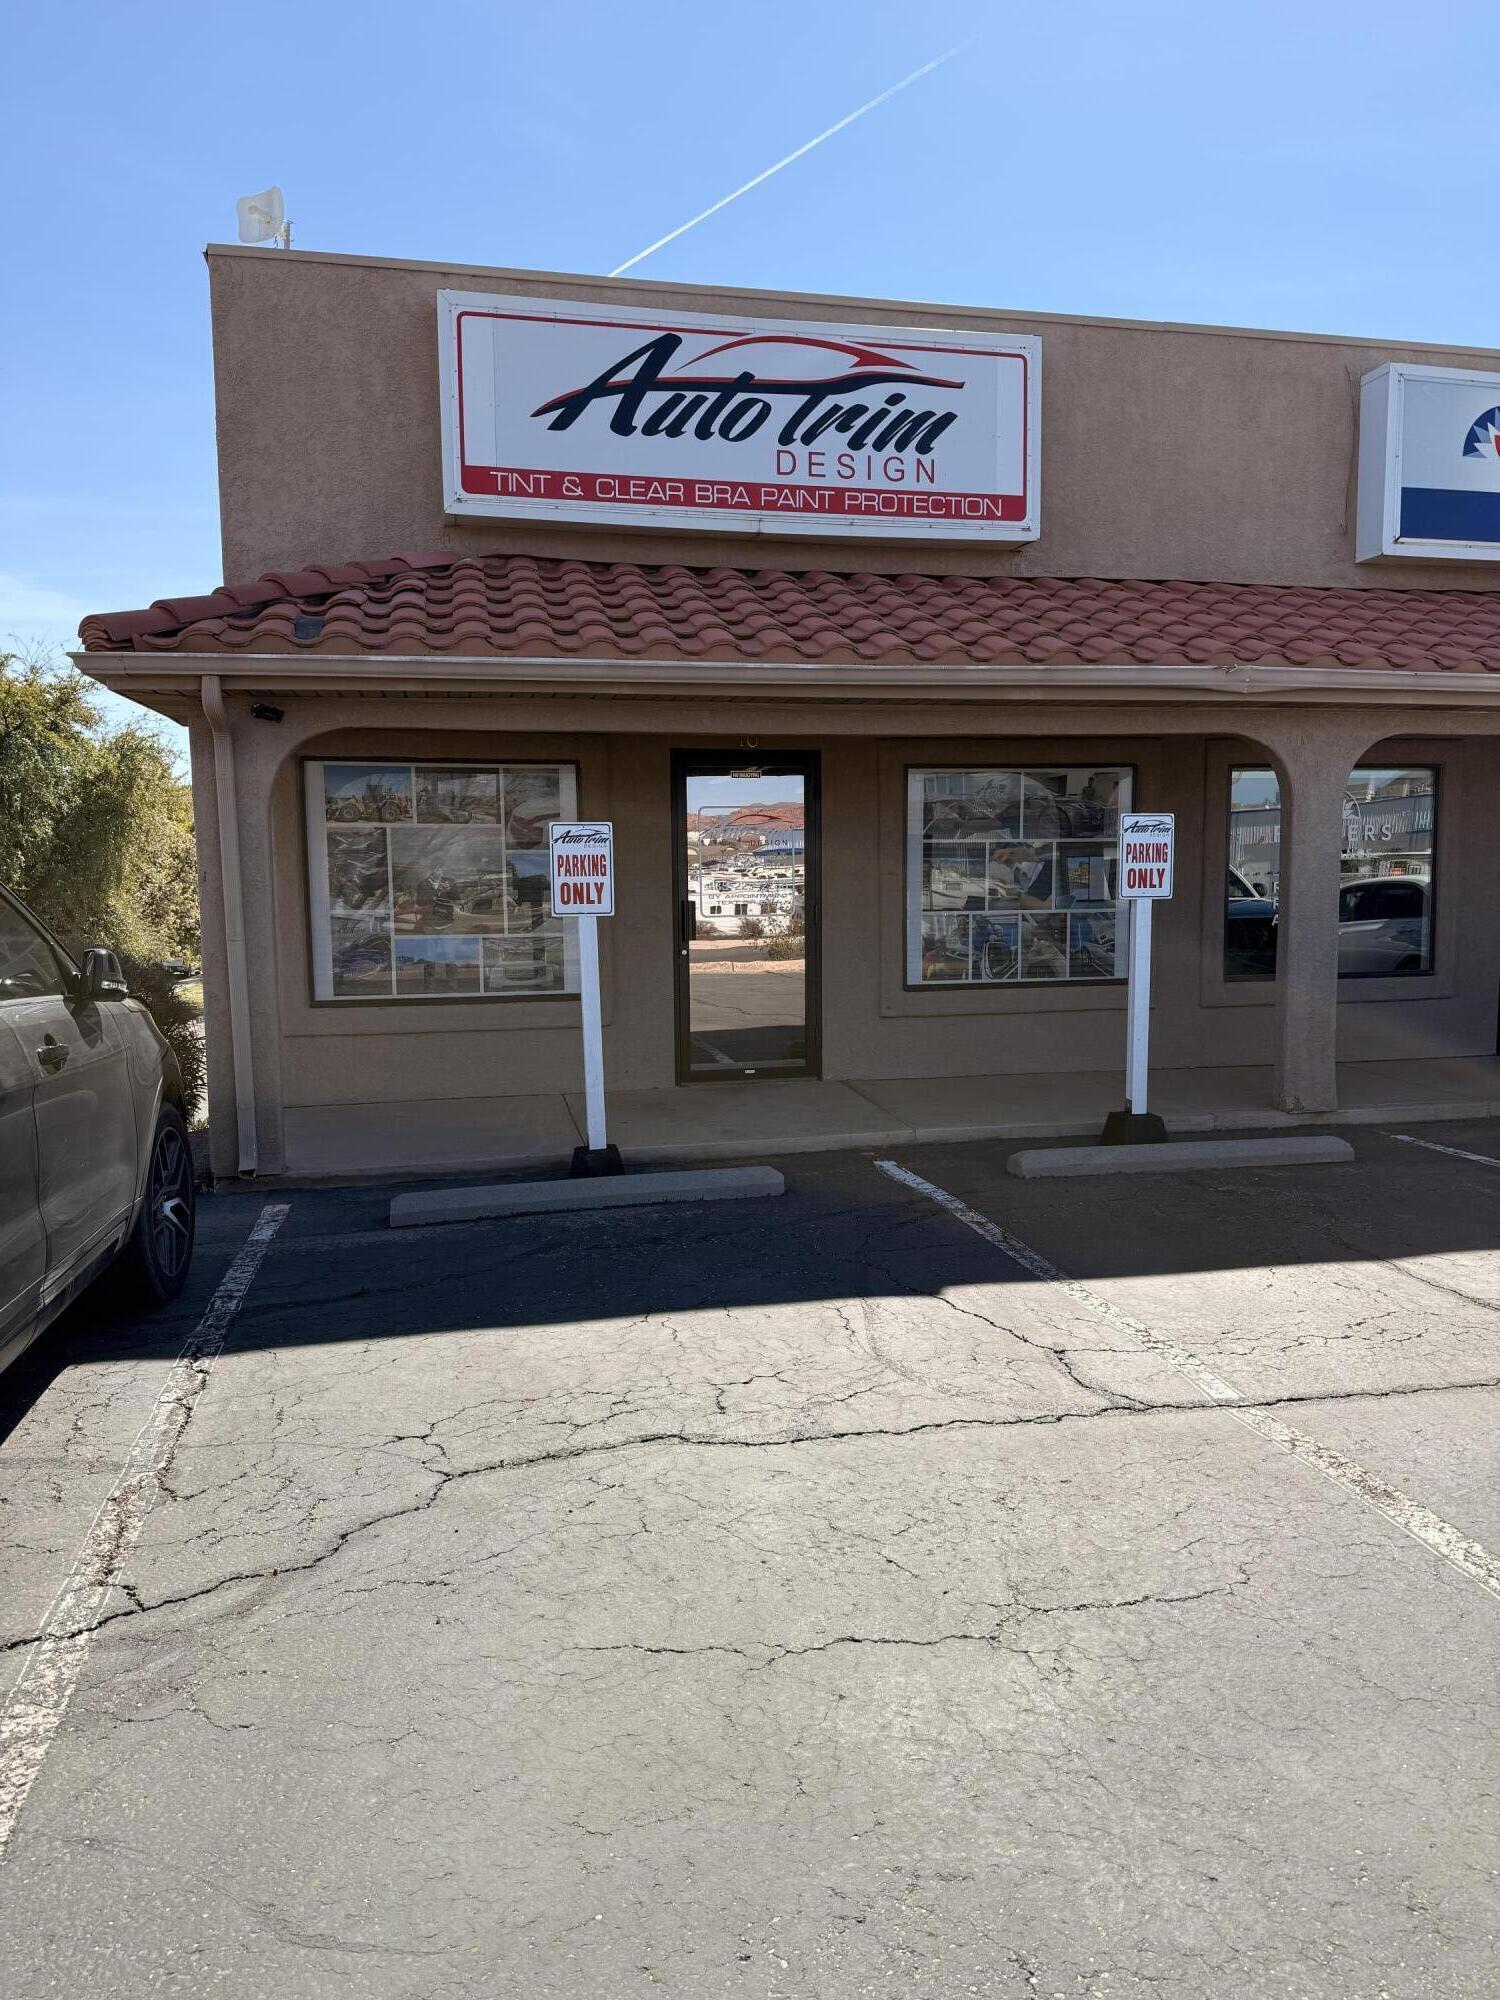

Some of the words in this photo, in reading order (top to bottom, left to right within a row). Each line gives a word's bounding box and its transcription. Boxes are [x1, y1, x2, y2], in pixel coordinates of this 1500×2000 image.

[536, 333, 772, 442] Auto
[776, 389, 958, 456] Trim
[775, 449, 936, 485] DESIGN
[489, 470, 552, 495] TINT
[562, 476, 585, 497] &
[595, 478, 685, 502] CLEAR
[694, 483, 751, 506] BRA
[760, 487, 836, 510] PAINT
[844, 491, 1002, 517] PROTECTION
[553, 830, 583, 844] Auto
[1125, 842, 1168, 863] PARKING
[557, 854, 607, 877] PARKING
[1127, 867, 1166, 889] ONLY
[560, 881, 605, 905] ONLY
